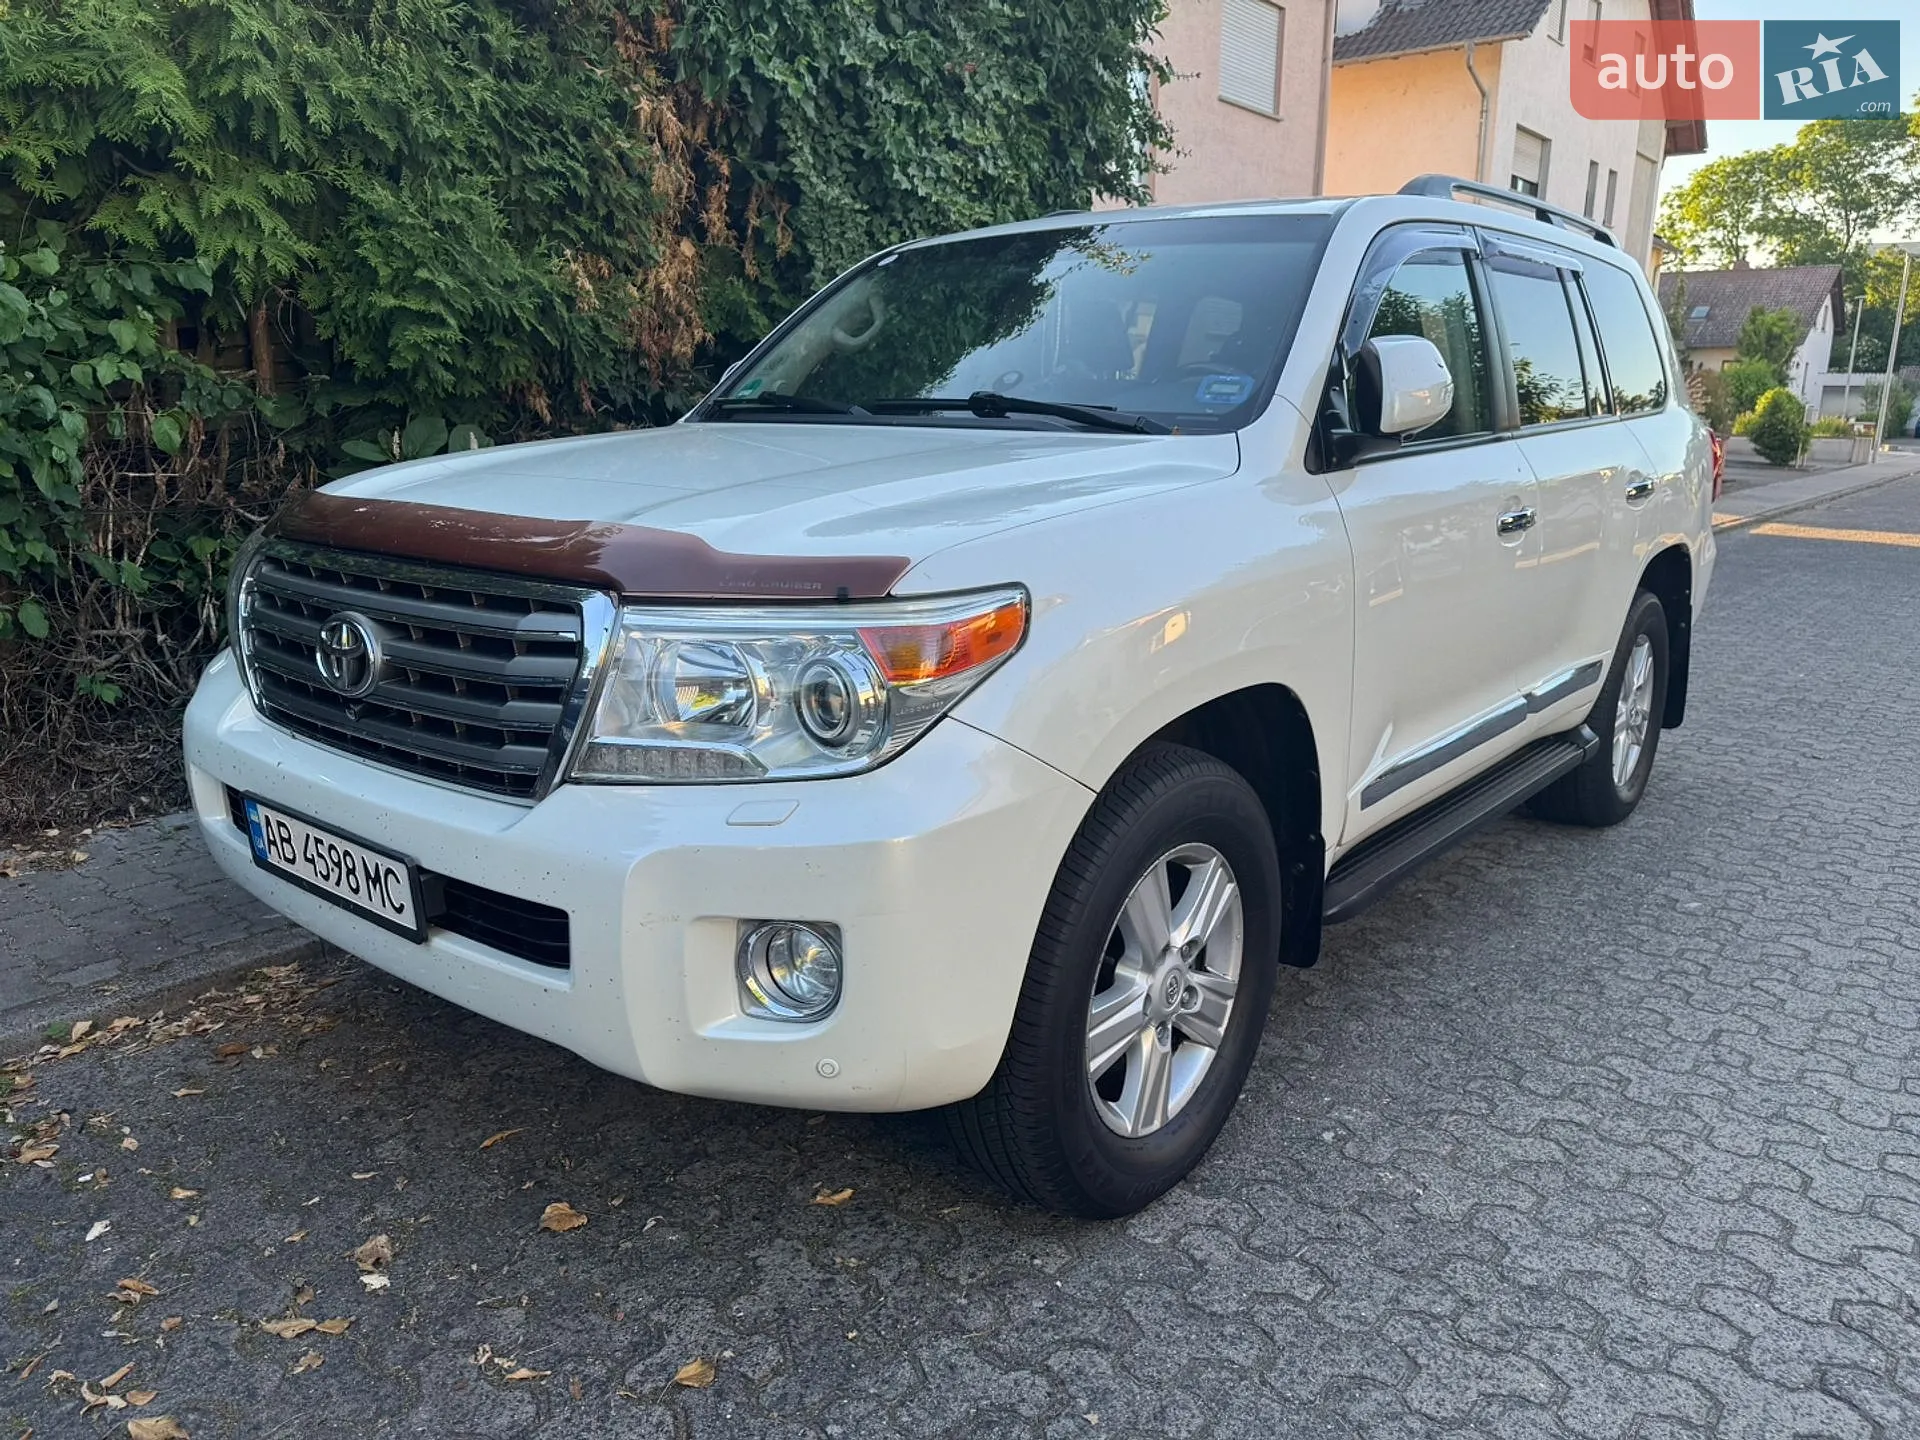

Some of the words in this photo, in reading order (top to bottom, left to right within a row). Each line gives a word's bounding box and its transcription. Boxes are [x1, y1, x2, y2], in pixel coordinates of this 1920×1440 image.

[264, 814, 297, 865] AB
[303, 833, 361, 895] 4598
[361, 854, 406, 914] MC
